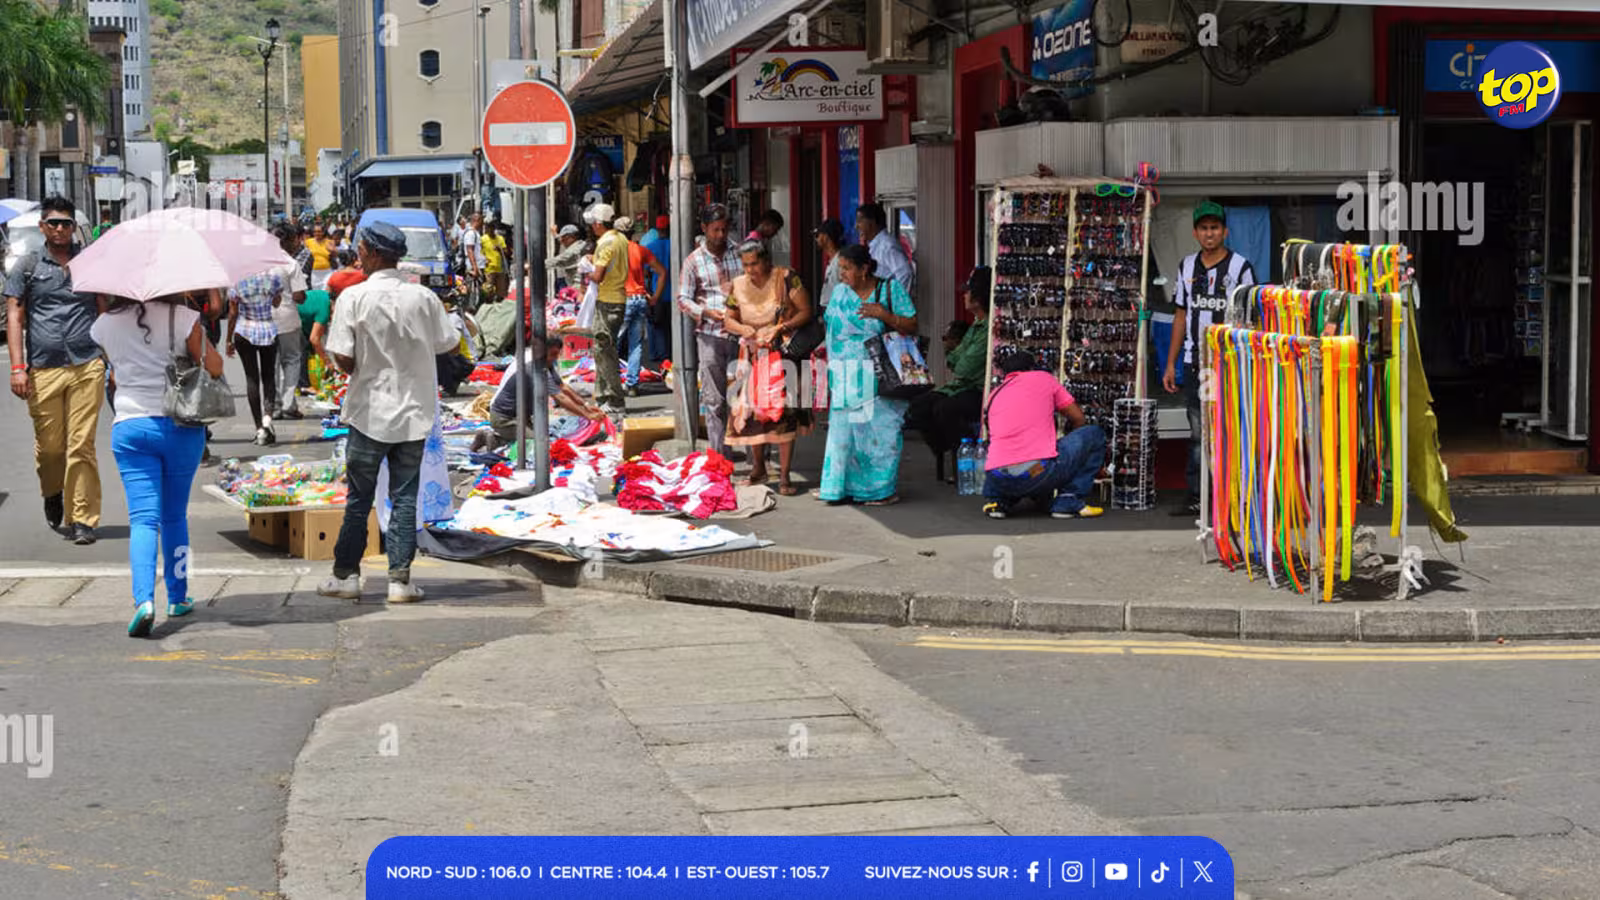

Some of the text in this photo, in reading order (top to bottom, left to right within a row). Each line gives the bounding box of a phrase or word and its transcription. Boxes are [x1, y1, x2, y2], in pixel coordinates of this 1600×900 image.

[784, 78, 875, 98] Arc-en-ciel
[817, 102, 871, 116] Boutique
[1192, 294, 1227, 311] Jeep
